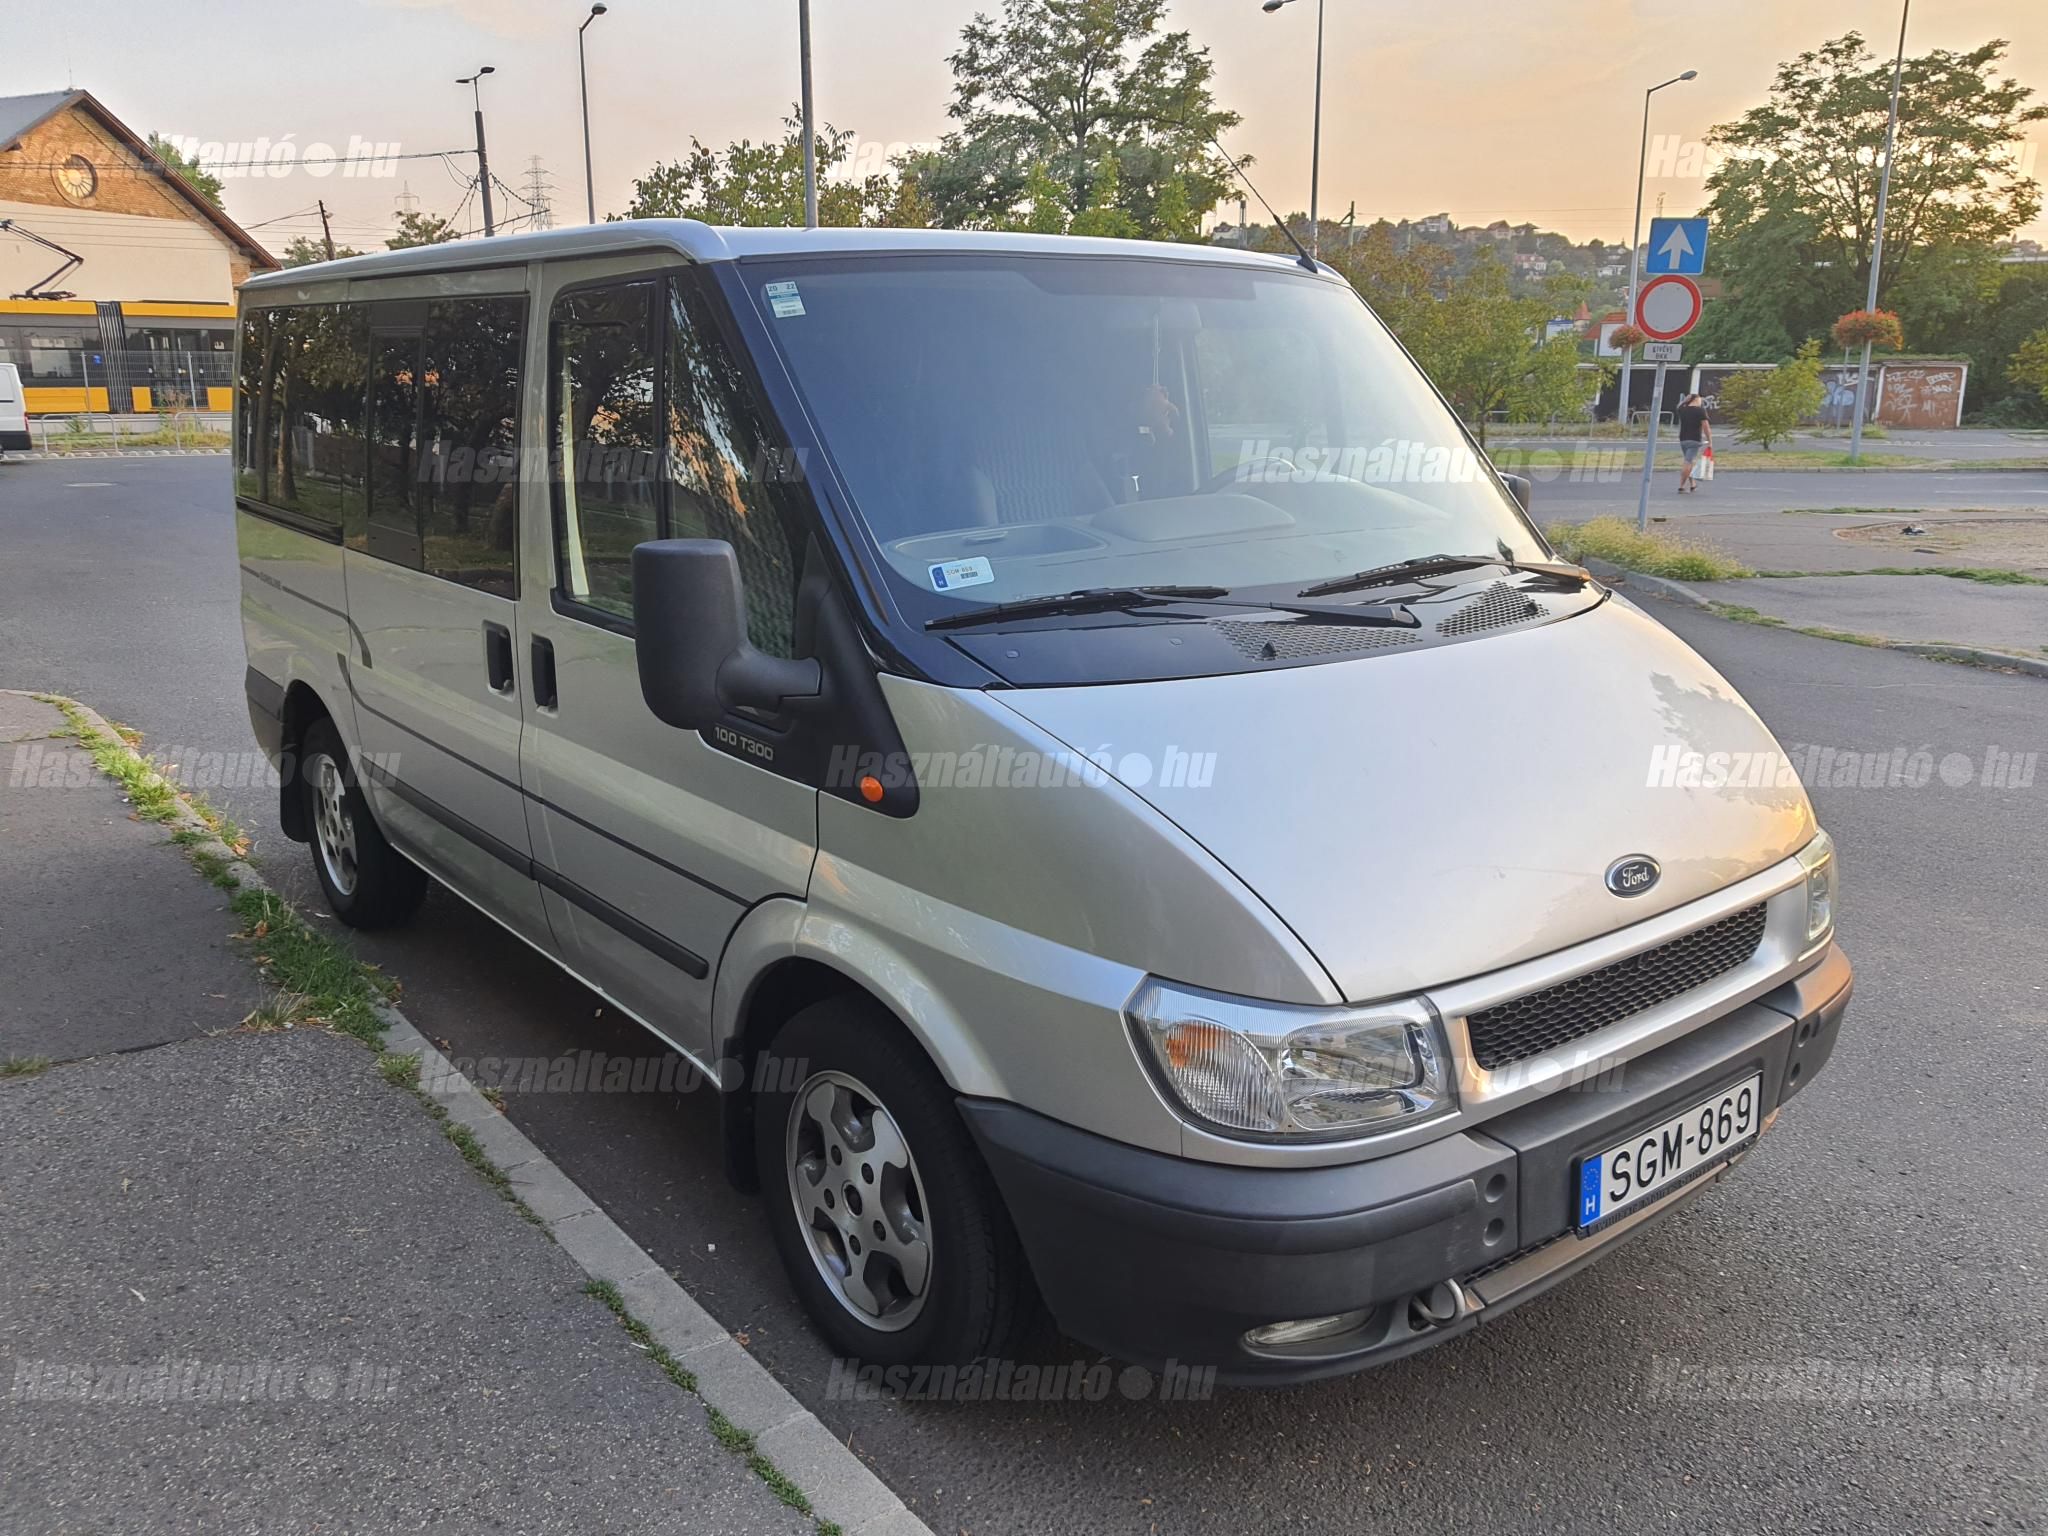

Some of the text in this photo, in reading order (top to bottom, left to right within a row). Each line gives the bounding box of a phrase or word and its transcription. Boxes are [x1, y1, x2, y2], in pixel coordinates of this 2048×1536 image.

[714, 726, 774, 761] 100 T300
[1622, 865, 1650, 888] Ford
[1610, 1087, 1752, 1203] SGM-869
[1585, 1194, 1596, 1216] H
